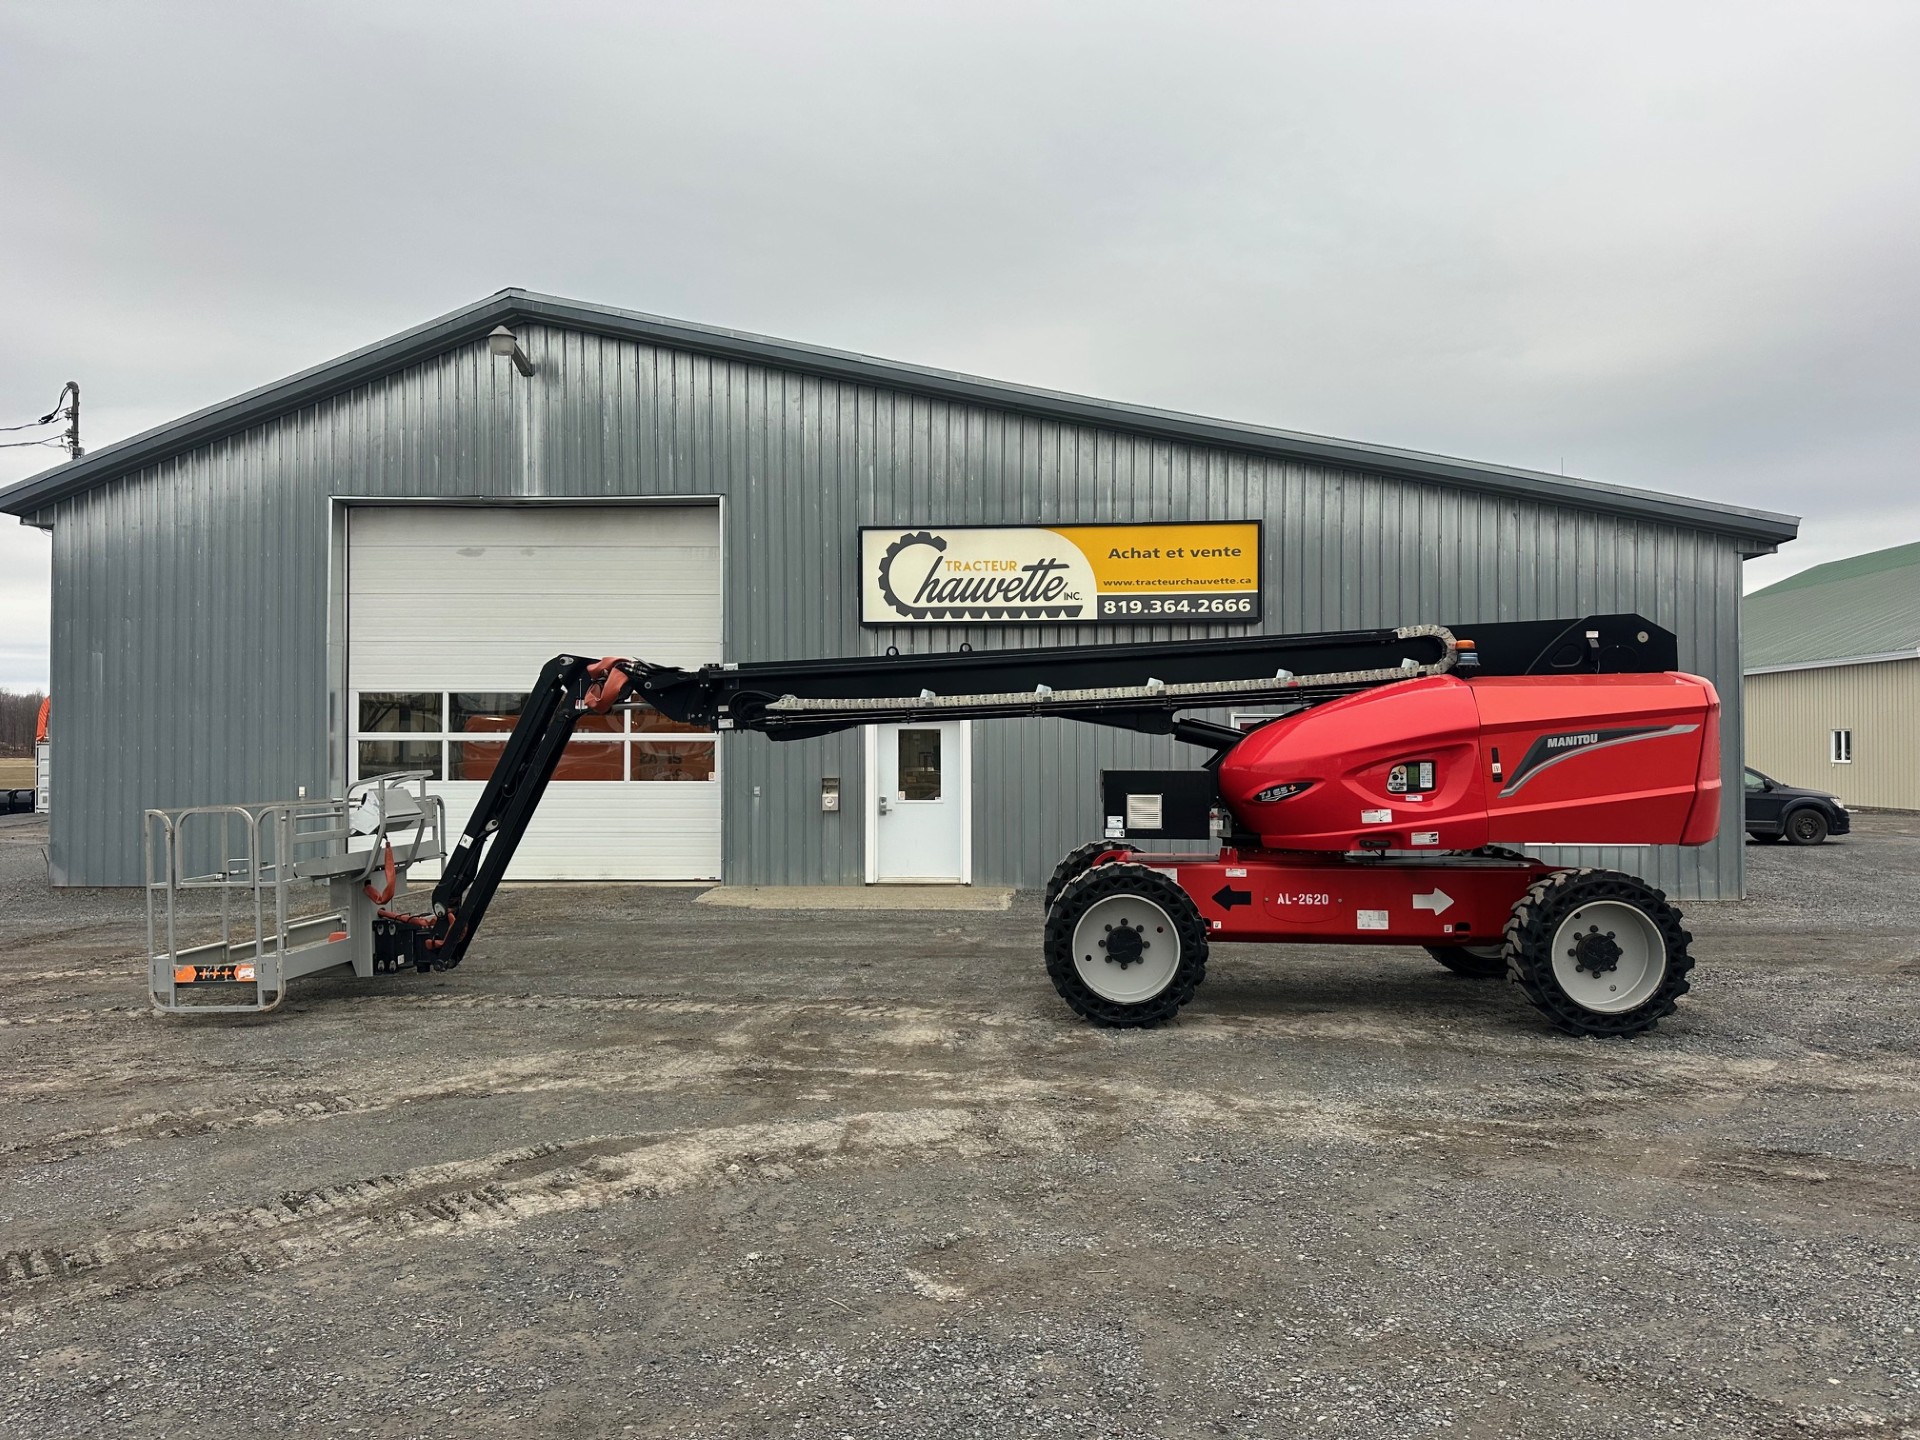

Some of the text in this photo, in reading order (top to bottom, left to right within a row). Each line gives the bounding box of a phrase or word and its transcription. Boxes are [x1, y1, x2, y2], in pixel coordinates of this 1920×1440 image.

[1108, 546, 1242, 559] Achat et vente
[878, 531, 1083, 610] Chauvette INC.
[945, 560, 1018, 572] TRACTEUR
[1103, 577, 1252, 587] www.tracteurchauvette.ca
[1103, 598, 1251, 614] 819.364.2666
[1547, 733, 1598, 748] MANITOU
[1259, 790, 1272, 799] TJ
[1277, 893, 1329, 905] AL-2620
